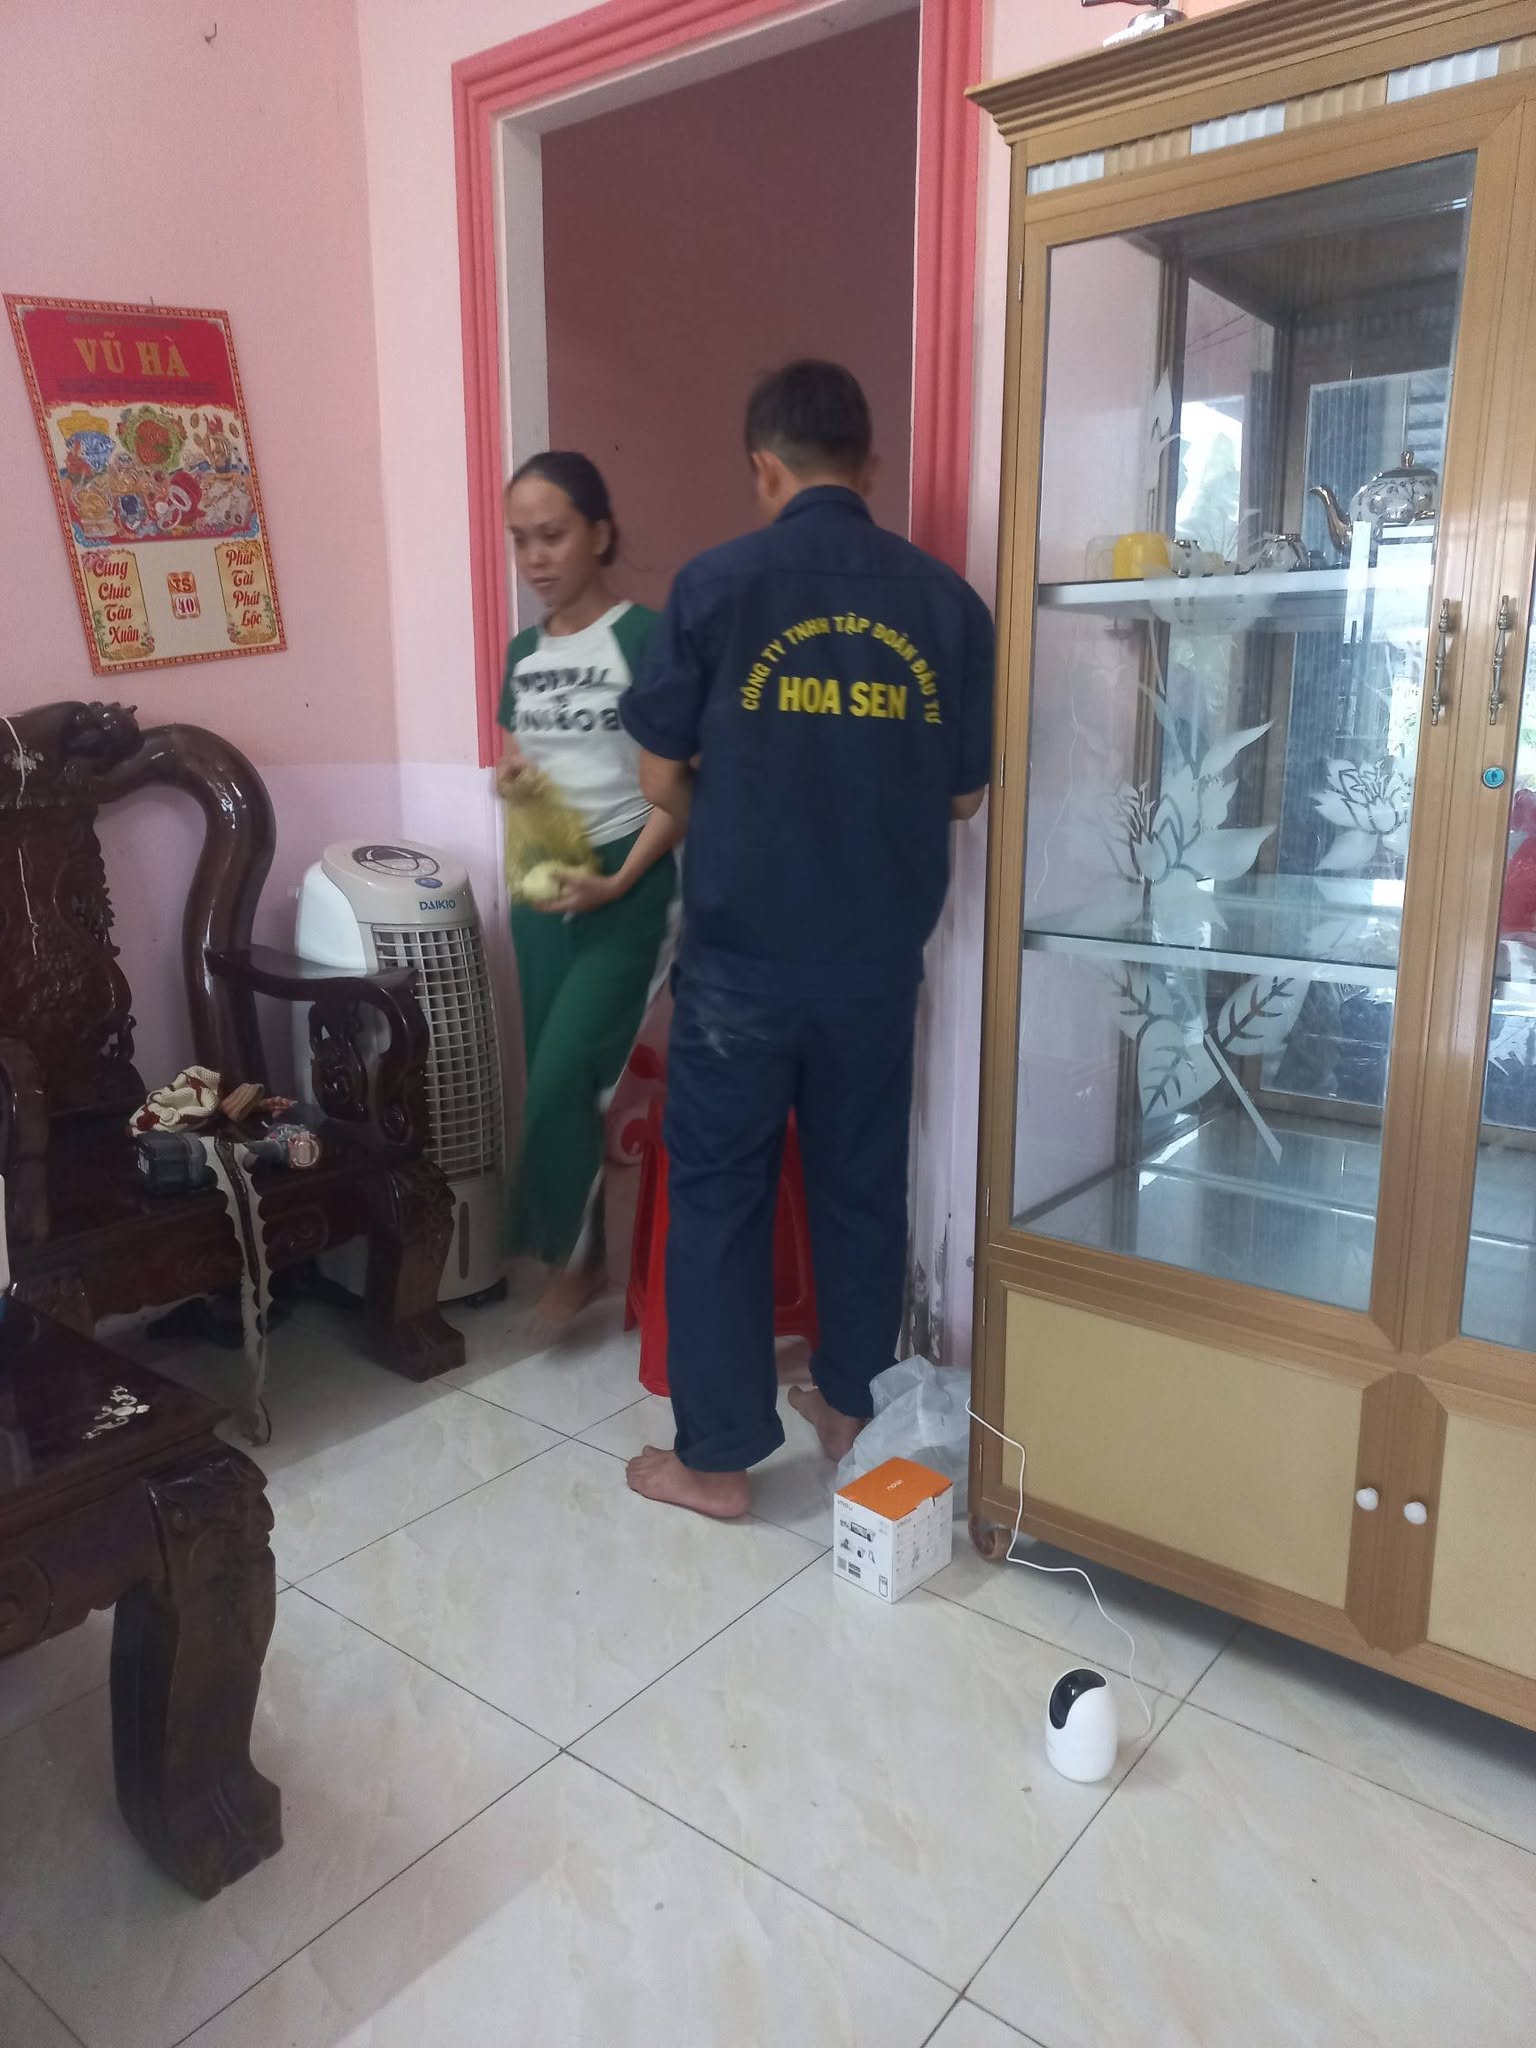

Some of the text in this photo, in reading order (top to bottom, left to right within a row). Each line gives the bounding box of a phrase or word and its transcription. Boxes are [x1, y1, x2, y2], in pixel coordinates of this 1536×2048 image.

[74, 331, 190, 377] VŨ HÀ
[93, 560, 128, 580] Cung
[231, 569, 254, 587] Tài
[98, 582, 132, 601] Chúc
[232, 590, 261, 609] Phát
[104, 604, 133, 622] Tân
[178, 597, 195, 614] 40
[241, 610, 263, 629] Lộc
[109, 626, 139, 645] Xuân
[740, 663, 772, 711] CÔNG
[761, 639, 787, 662] TY
[782, 617, 831, 645] TNHH
[832, 612, 871, 635] TẬP
[778, 676, 908, 720] HOA SEN
[419, 900, 456, 911] DAIKIO
